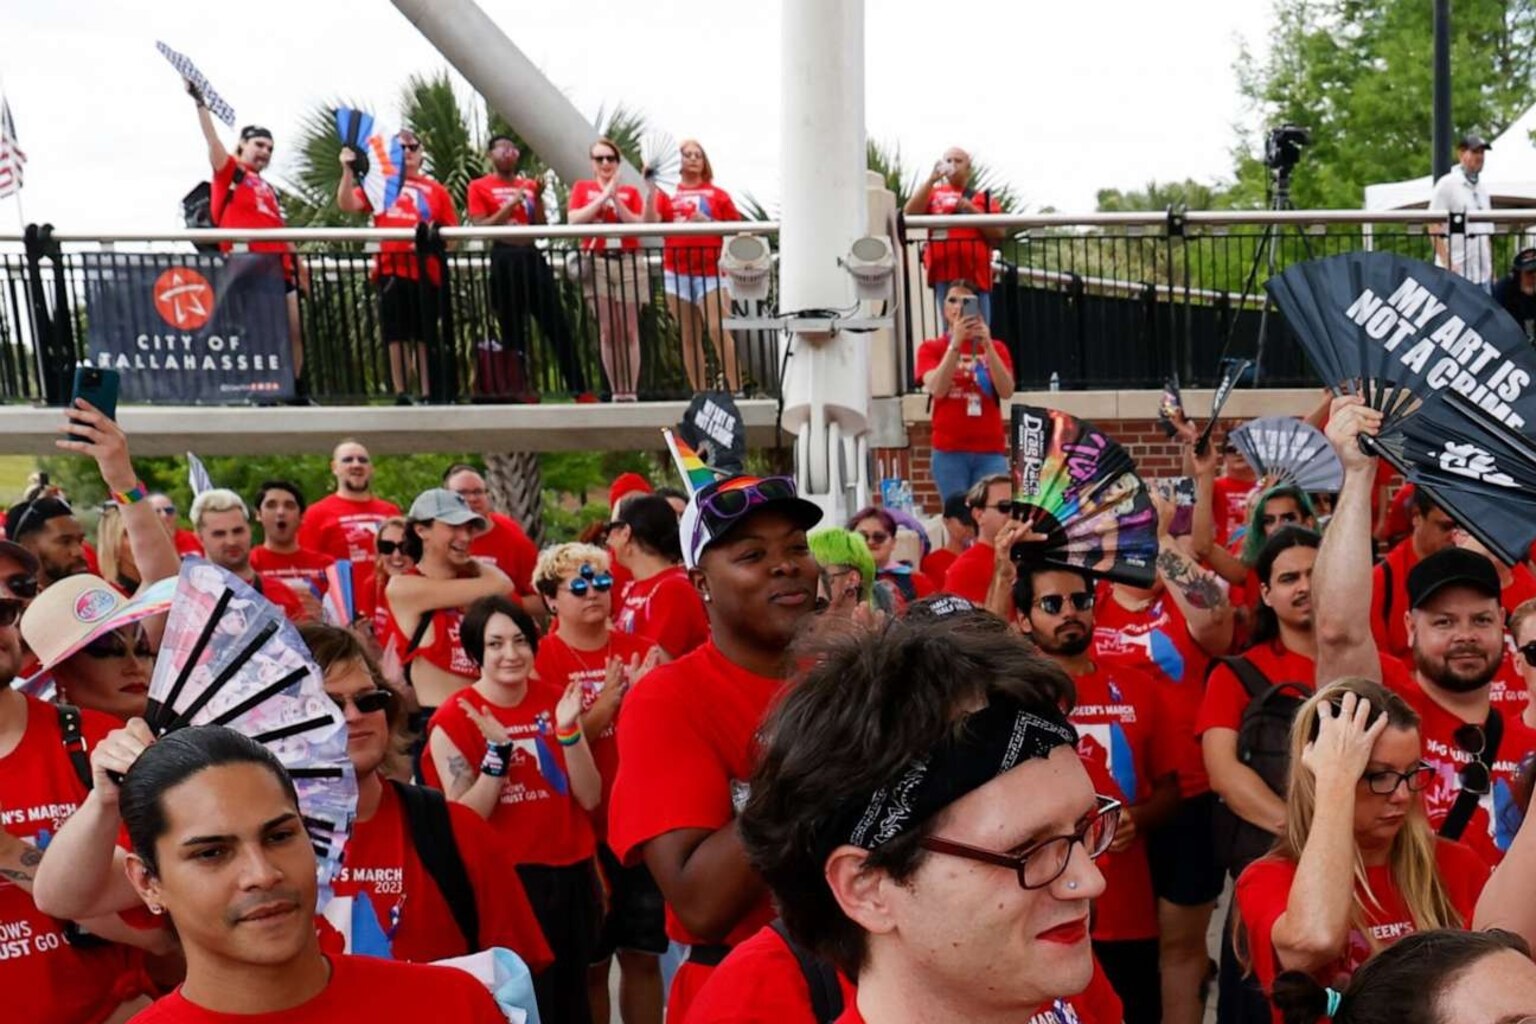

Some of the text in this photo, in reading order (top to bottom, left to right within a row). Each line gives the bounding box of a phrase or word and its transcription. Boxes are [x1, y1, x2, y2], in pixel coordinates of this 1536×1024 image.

[1346, 288, 1417, 352] NOT
[1400, 338, 1436, 374] A
[1387, 276, 1530, 403] MY ART IS
[136, 334, 240, 350] CITY OF
[98, 352, 280, 370] TALLAHASSEE
[1023, 413, 1043, 456] Drag
[353, 867, 403, 882] MARCH
[374, 881, 403, 894] 2023
[1368, 922, 1415, 939] EEN'S
[34, 932, 60, 952] GO
